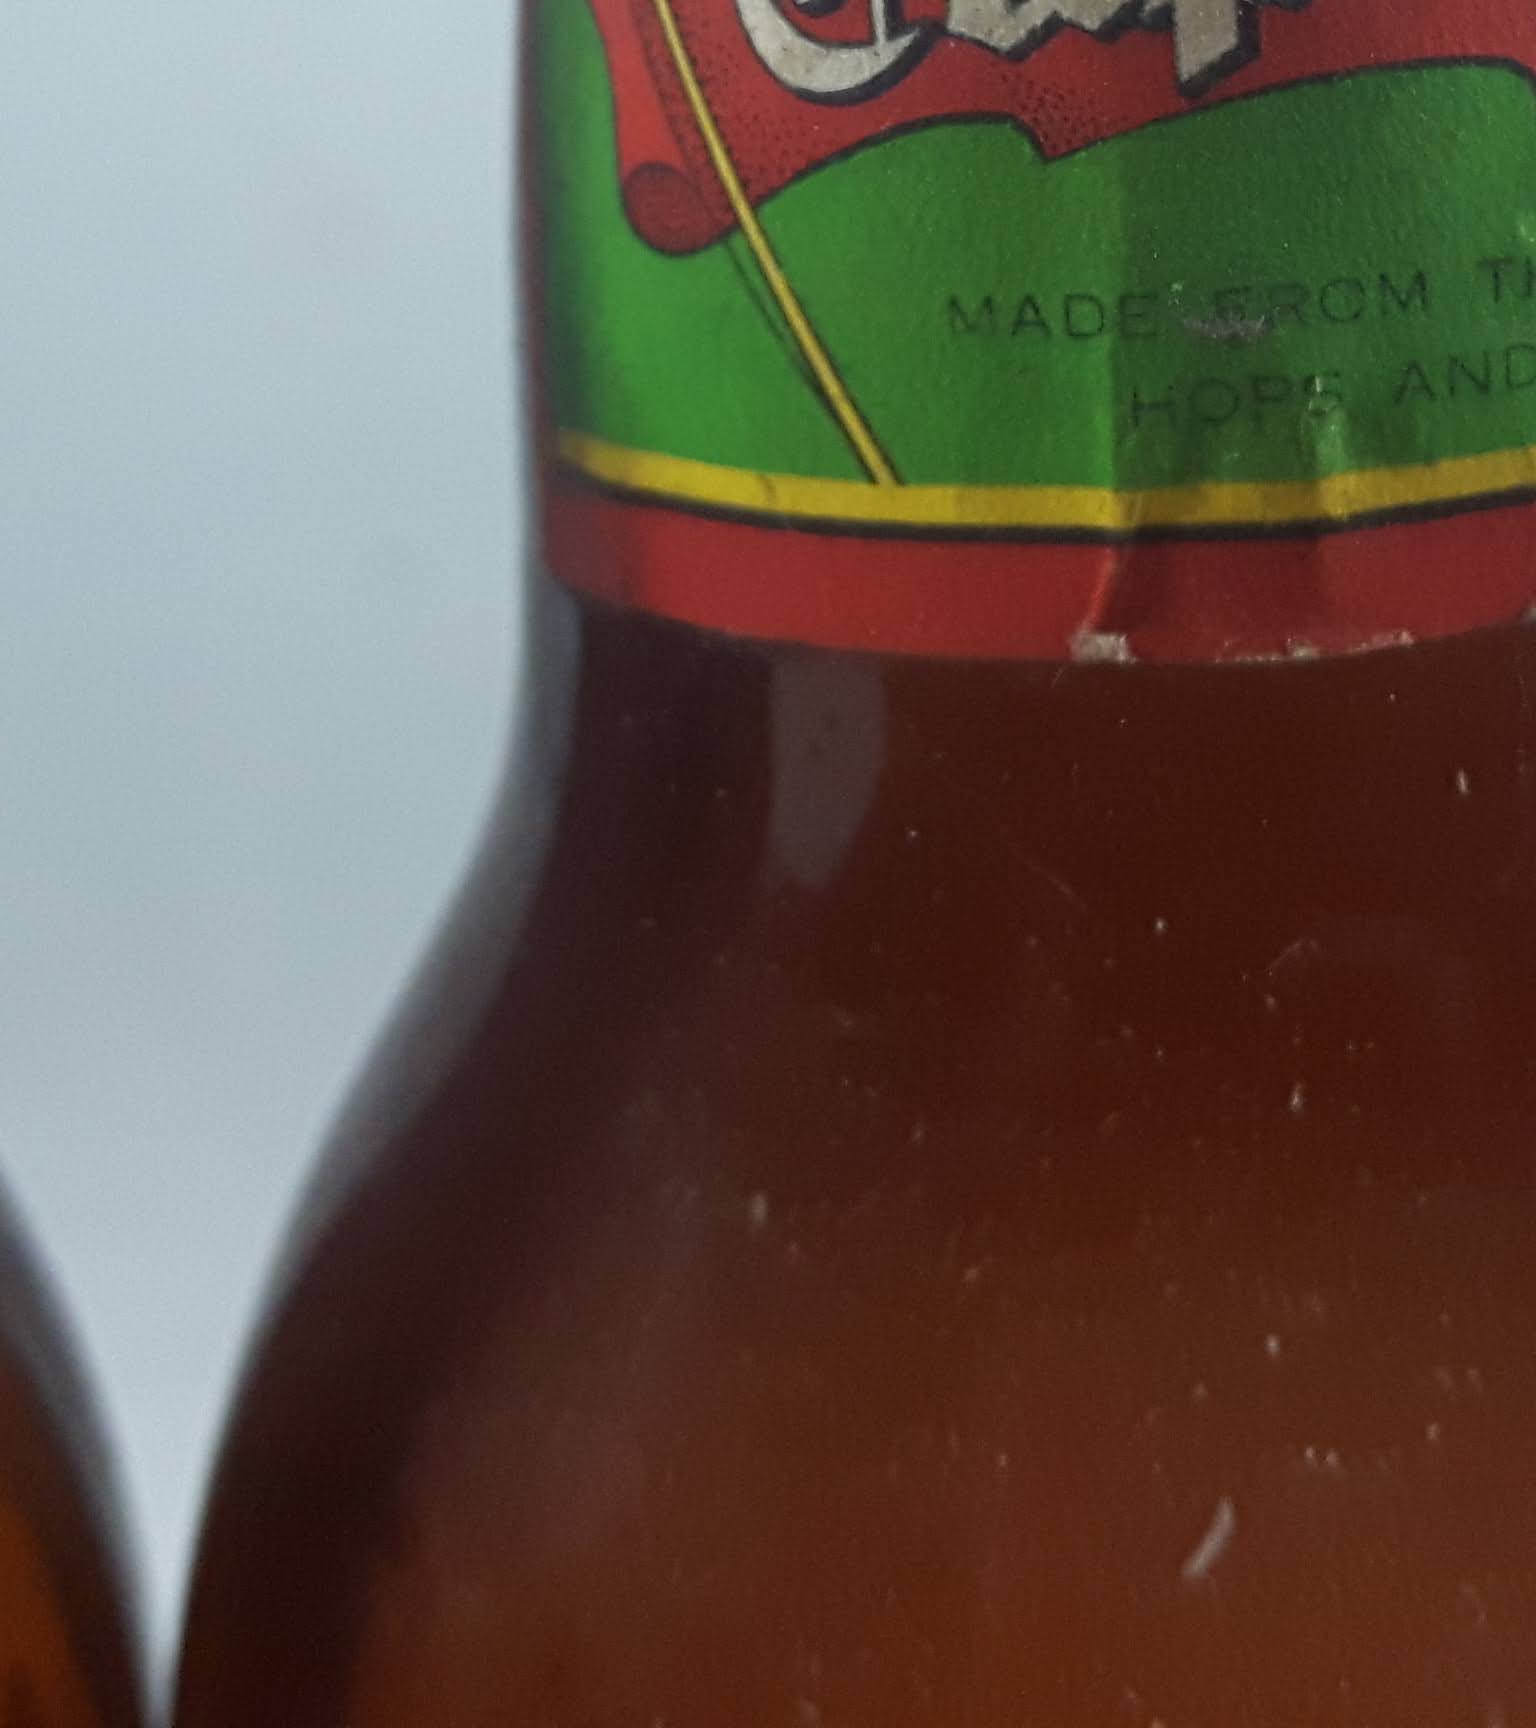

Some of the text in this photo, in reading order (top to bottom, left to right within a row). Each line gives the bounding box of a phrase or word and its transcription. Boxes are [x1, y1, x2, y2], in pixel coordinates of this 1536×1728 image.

[946, 291, 1162, 340] MADE
[1214, 268, 1431, 333] FROM
[1129, 371, 1343, 429] HOPS
